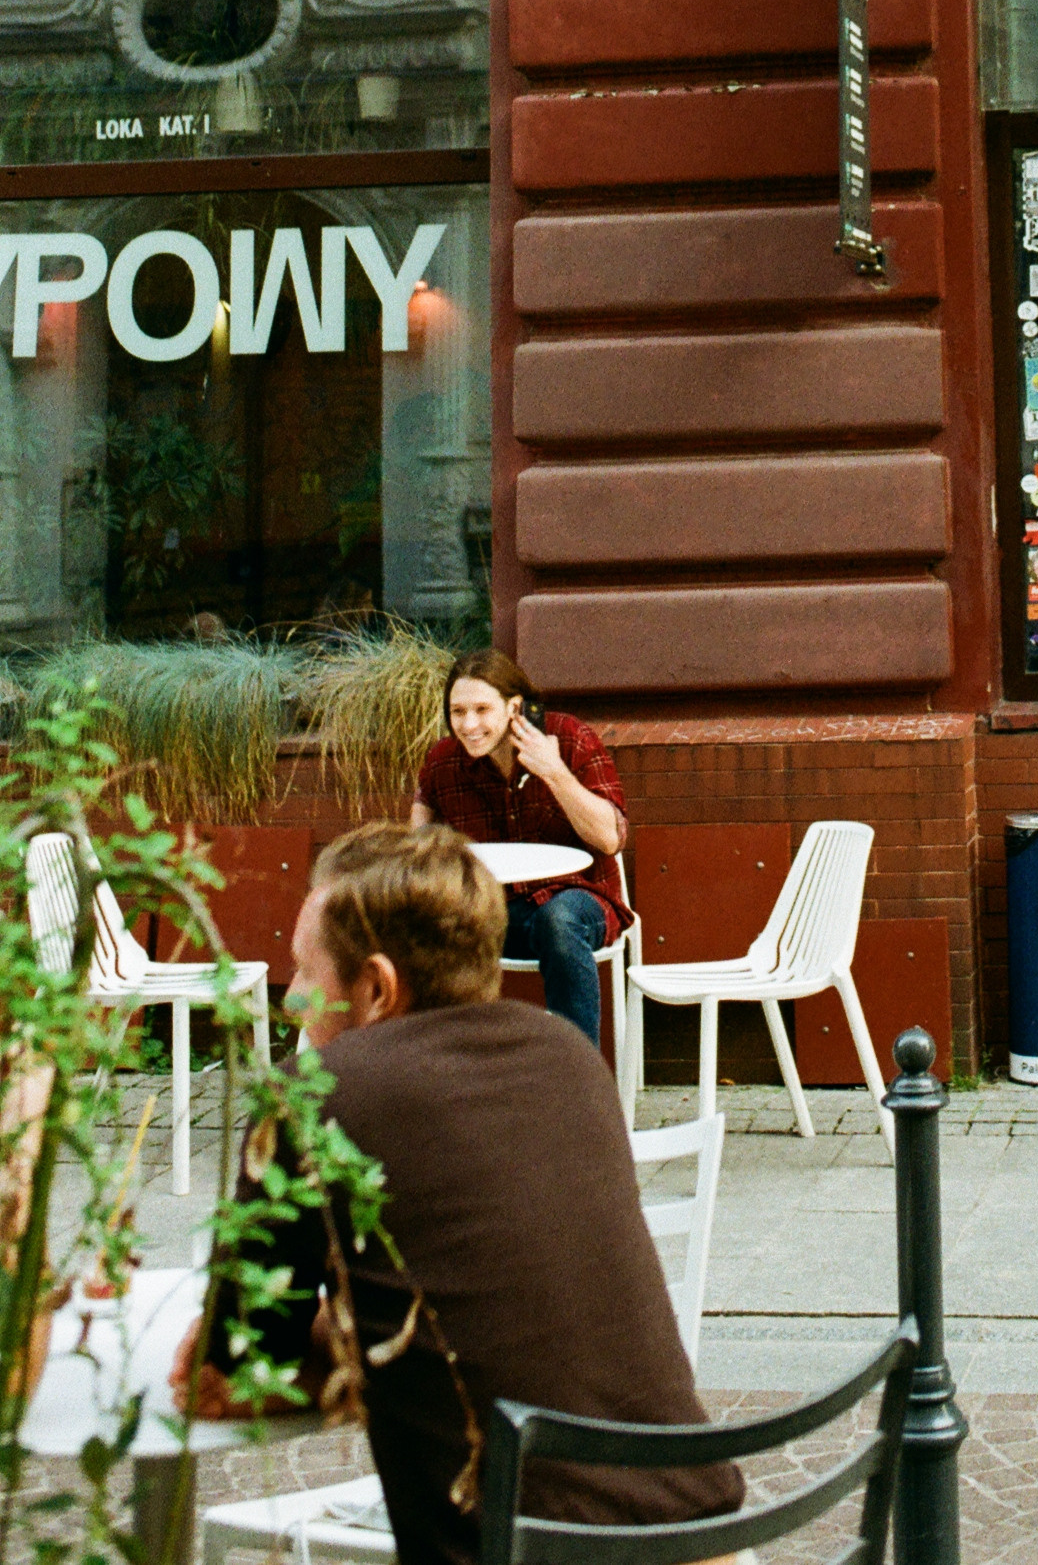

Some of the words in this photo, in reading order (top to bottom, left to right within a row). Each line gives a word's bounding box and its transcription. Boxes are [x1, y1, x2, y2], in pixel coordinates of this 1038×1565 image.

[96, 118, 144, 140] LOKA
[159, 115, 197, 137] KAT.
[0, 224, 446, 362] POWY
